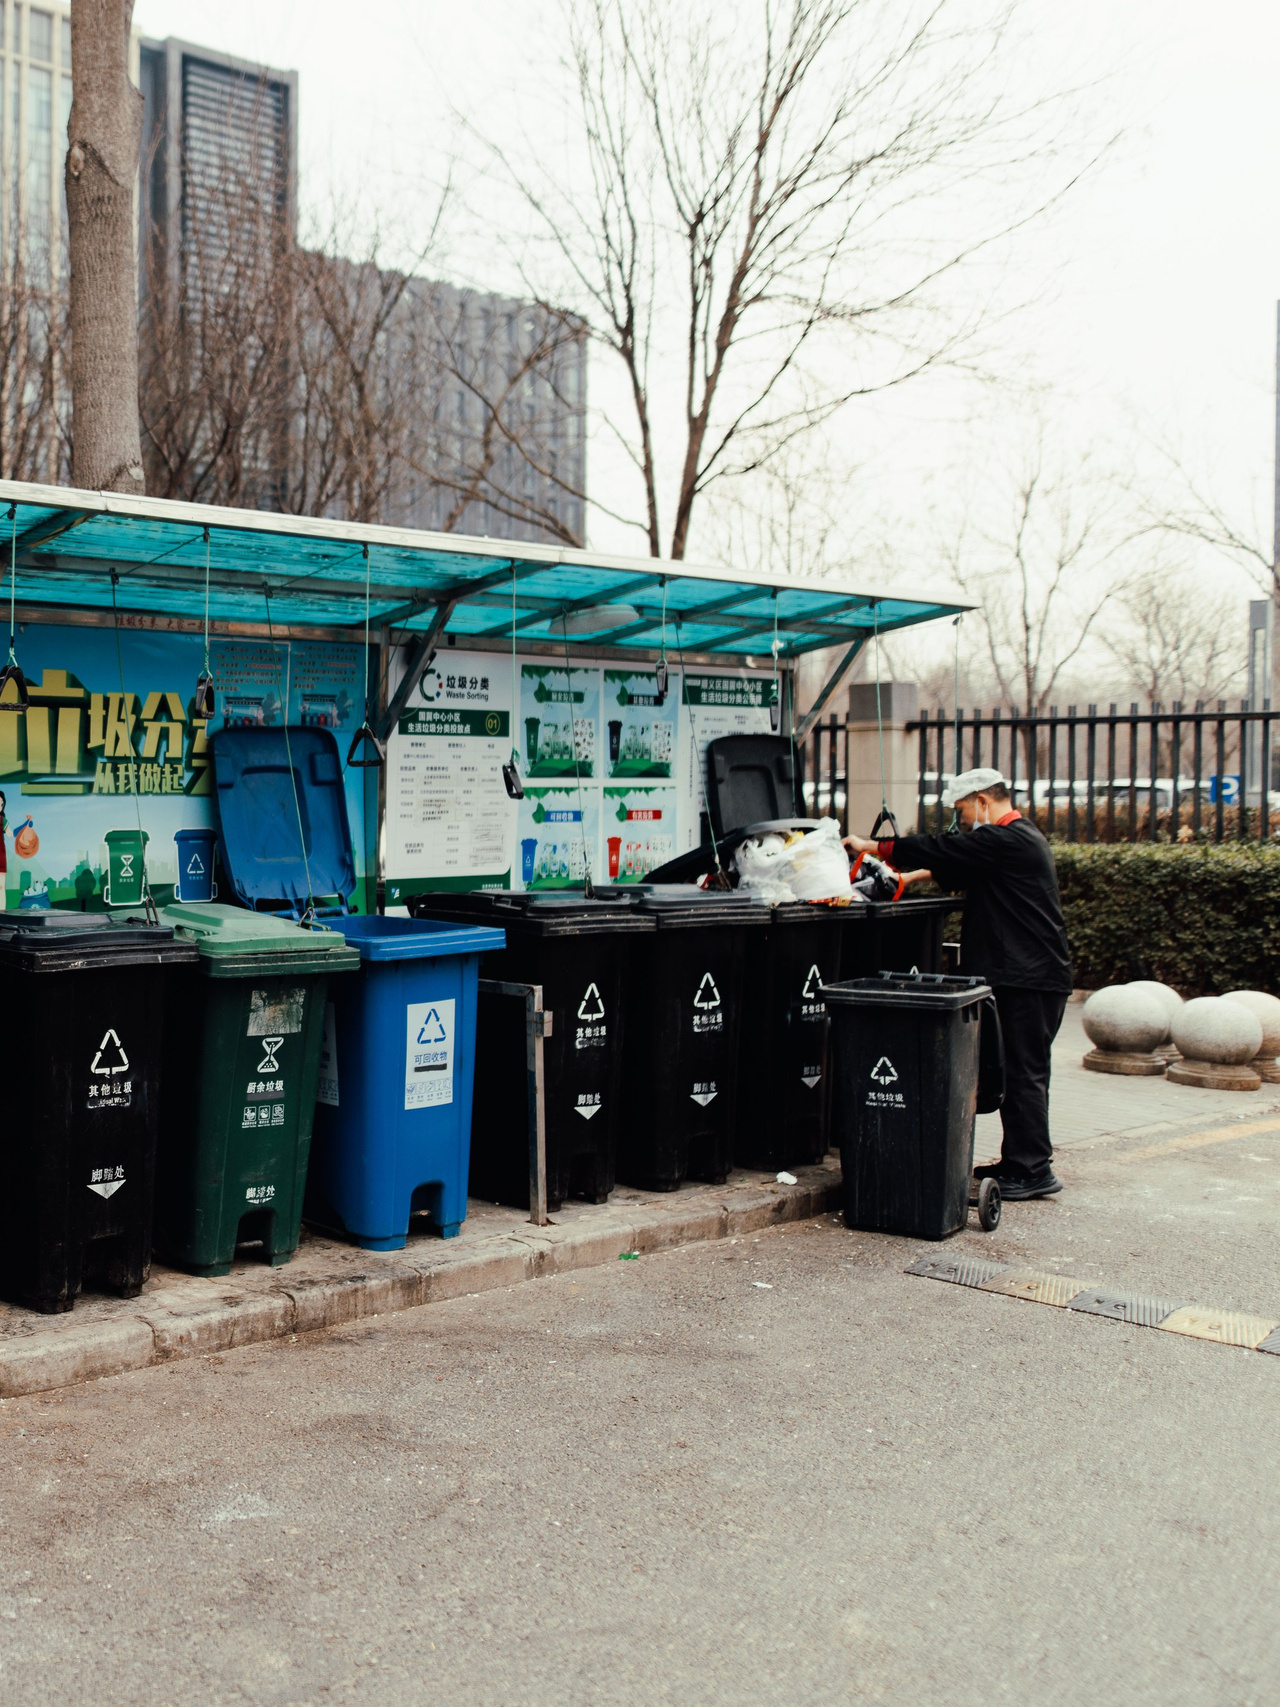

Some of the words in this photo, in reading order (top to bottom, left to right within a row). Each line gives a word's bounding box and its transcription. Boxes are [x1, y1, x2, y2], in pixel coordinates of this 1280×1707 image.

[446, 675, 489, 691] 垃圾分类
[446, 691, 465, 700] Waste
[466, 691, 489, 703] Sorting
[408, 722, 471, 734] 生活垃圾分类投放点
[488, 719, 497, 729] 01
[92, 762, 185, 795] 从我做起
[576, 1025, 607, 1039] 其他垃圾
[414, 1050, 448, 1065] 可回收物
[88, 1081, 132, 1098] 其他垃圾
[246, 1080, 284, 1094] 厨余垃圾
[868, 1092, 904, 1103] 其他垃圾
[90, 1165, 125, 1183] 脚踏处
